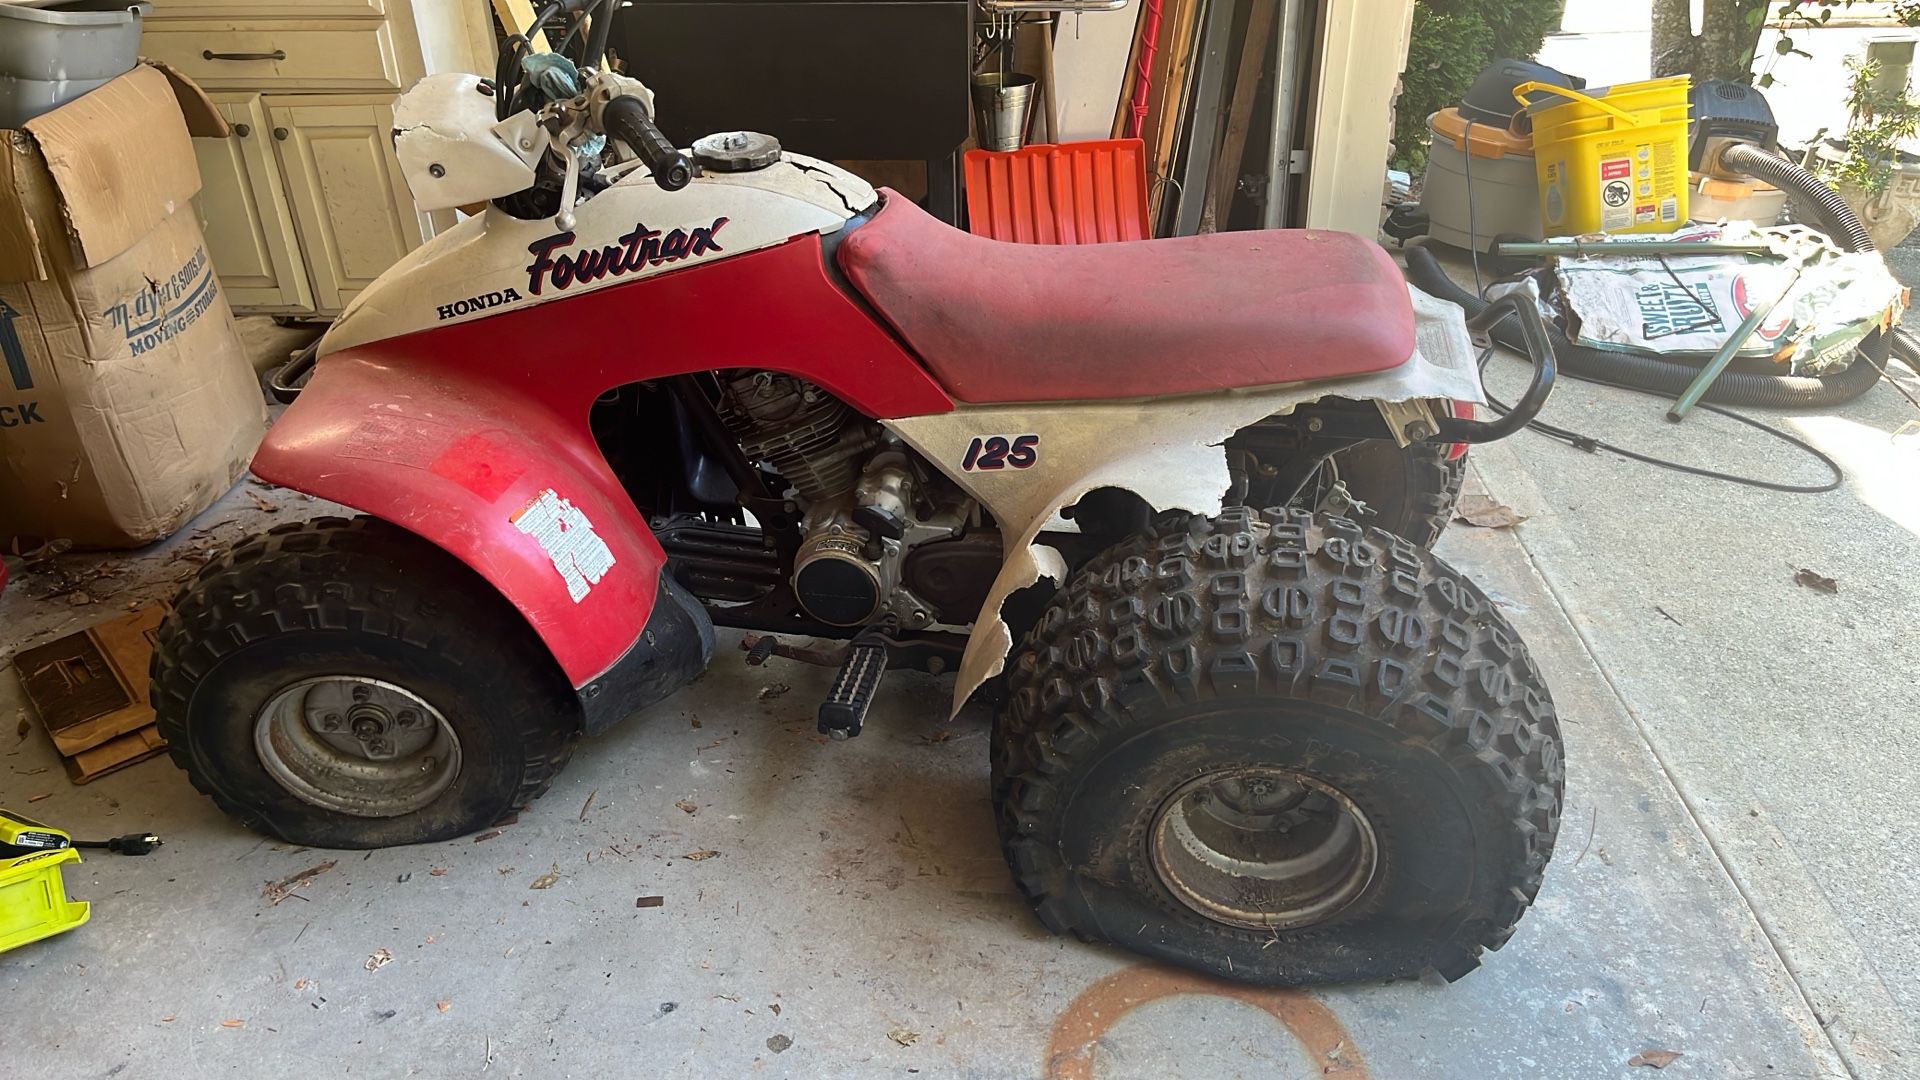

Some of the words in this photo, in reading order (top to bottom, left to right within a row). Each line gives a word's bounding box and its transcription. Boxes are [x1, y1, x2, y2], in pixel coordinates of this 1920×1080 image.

[526, 217, 730, 295] Fourtrax
[129, 316, 186, 357] MOVING
[194, 279, 218, 318] STORAGE
[437, 288, 522, 320] HONDA
[1635, 292, 1672, 334] SWEET
[962, 435, 1039, 471] 125
